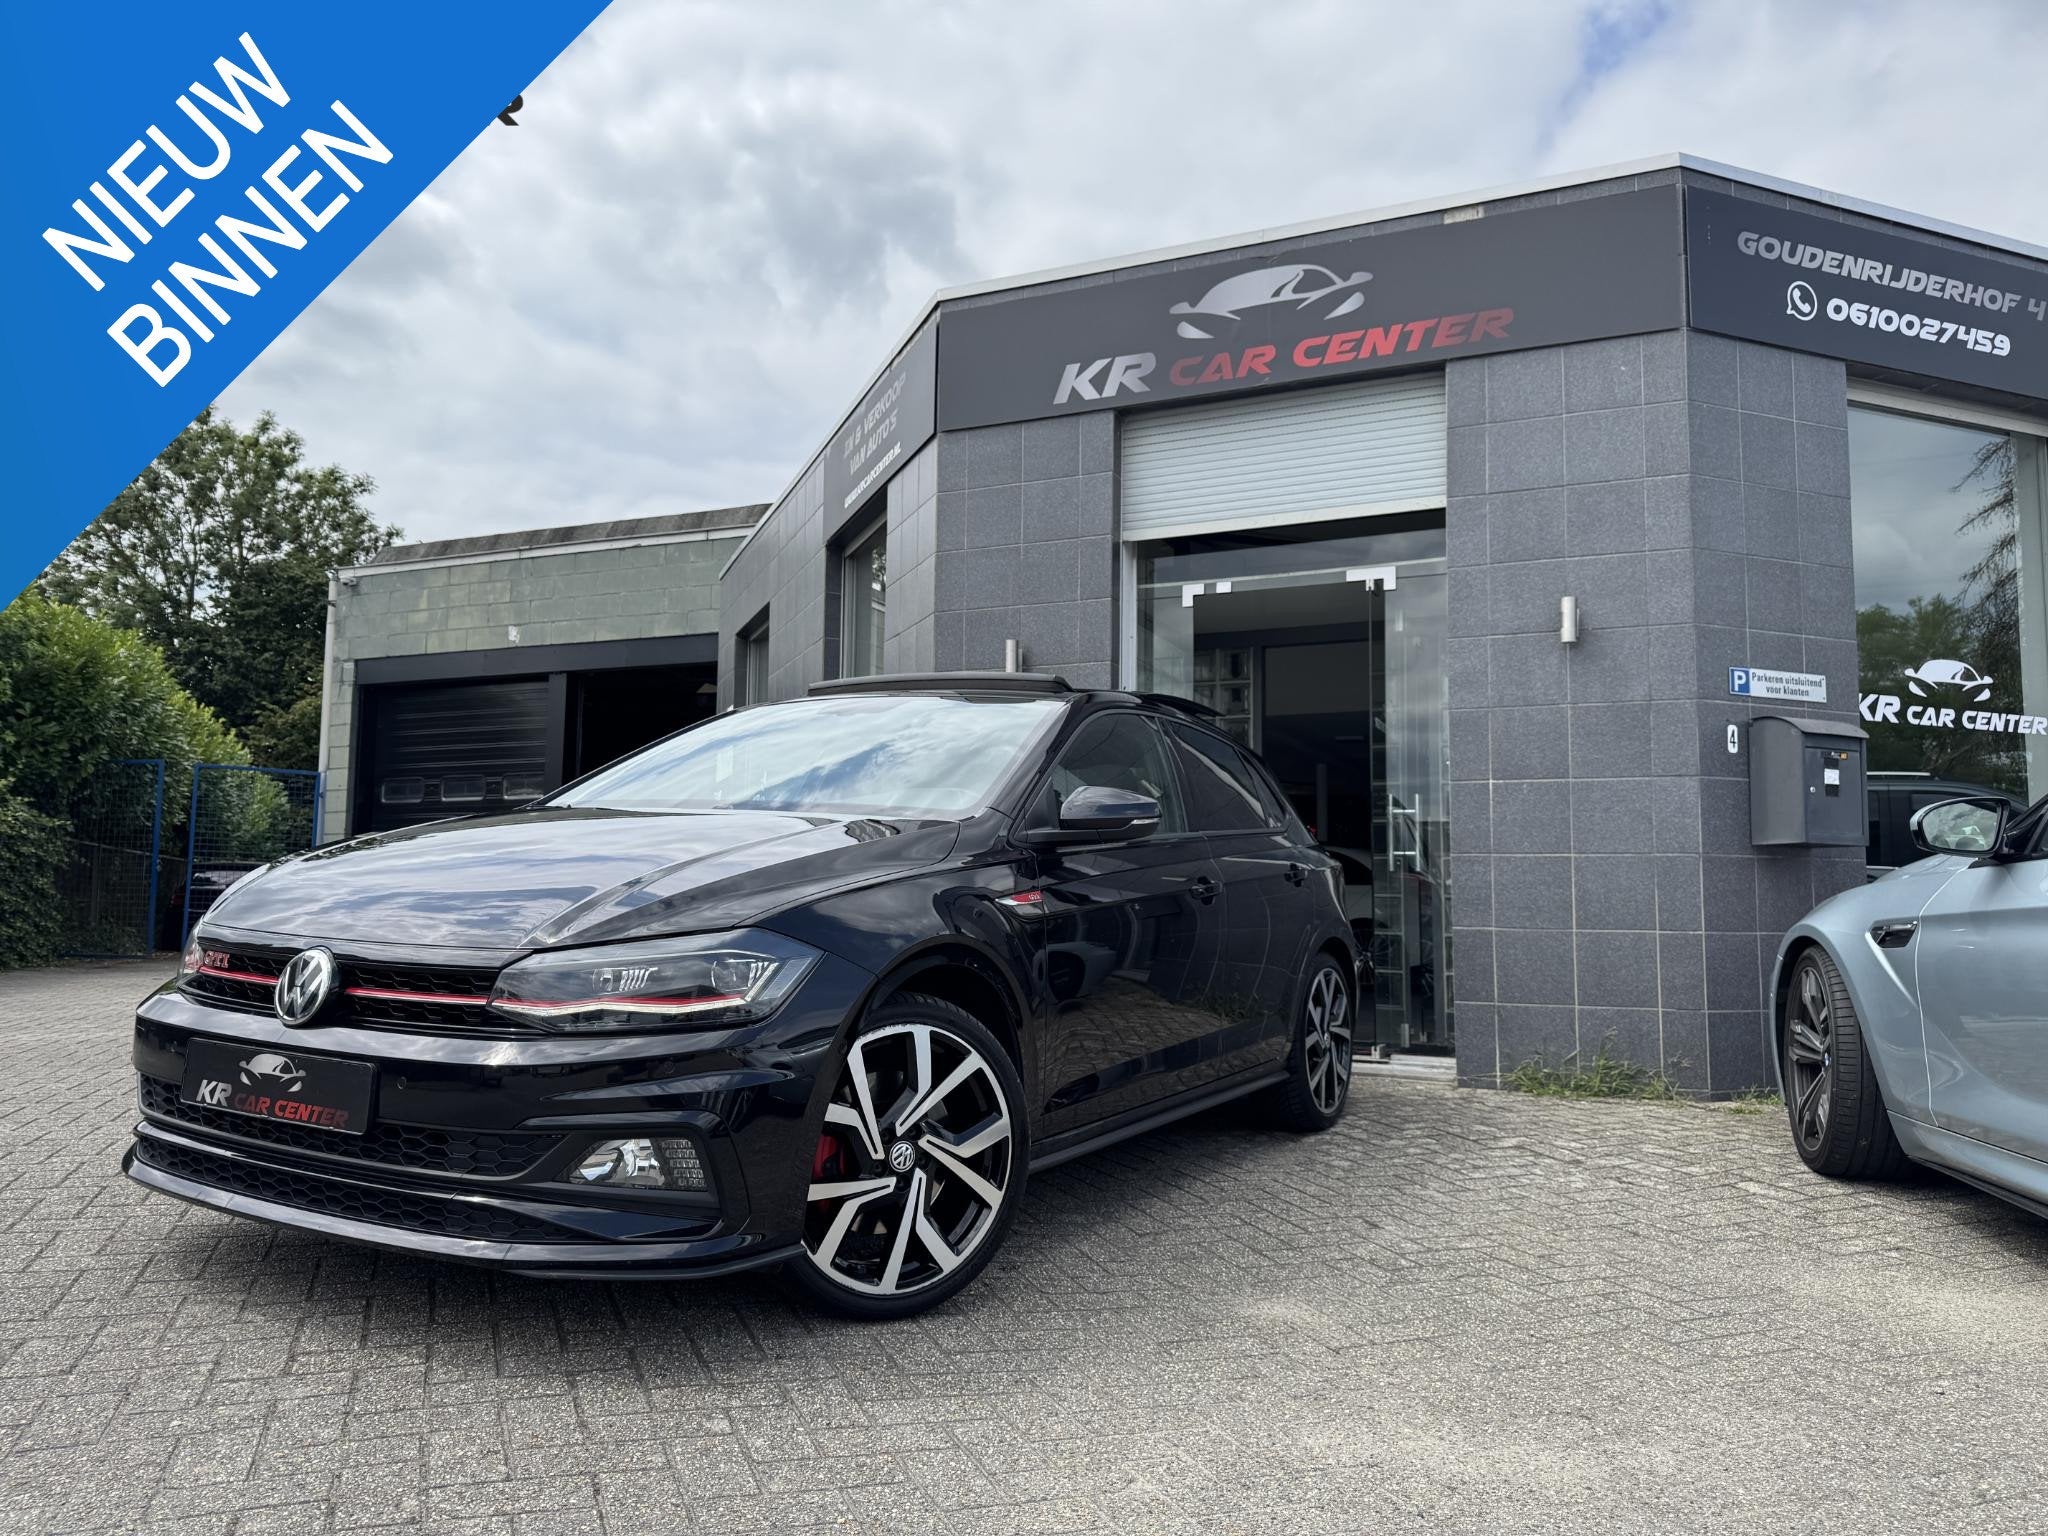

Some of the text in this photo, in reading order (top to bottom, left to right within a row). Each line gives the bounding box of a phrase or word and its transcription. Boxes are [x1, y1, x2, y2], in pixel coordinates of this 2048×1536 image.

[1737, 231, 2047, 321] GOUDENRIJDERHOF 4
[1826, 298, 2011, 357] 0610027459
[1053, 308, 1515, 404] KR CAR CENTER
[1733, 671, 1747, 692] P
[1752, 672, 1822, 688] Parkeren uitsluitend
[1766, 685, 1809, 697] voor klanten
[1859, 692, 2048, 736] KR CAR CENTER
[1729, 729, 1737, 750] 4
[203, 951, 231, 969] GTI
[196, 1079, 349, 1128] KR CAR CENTER
